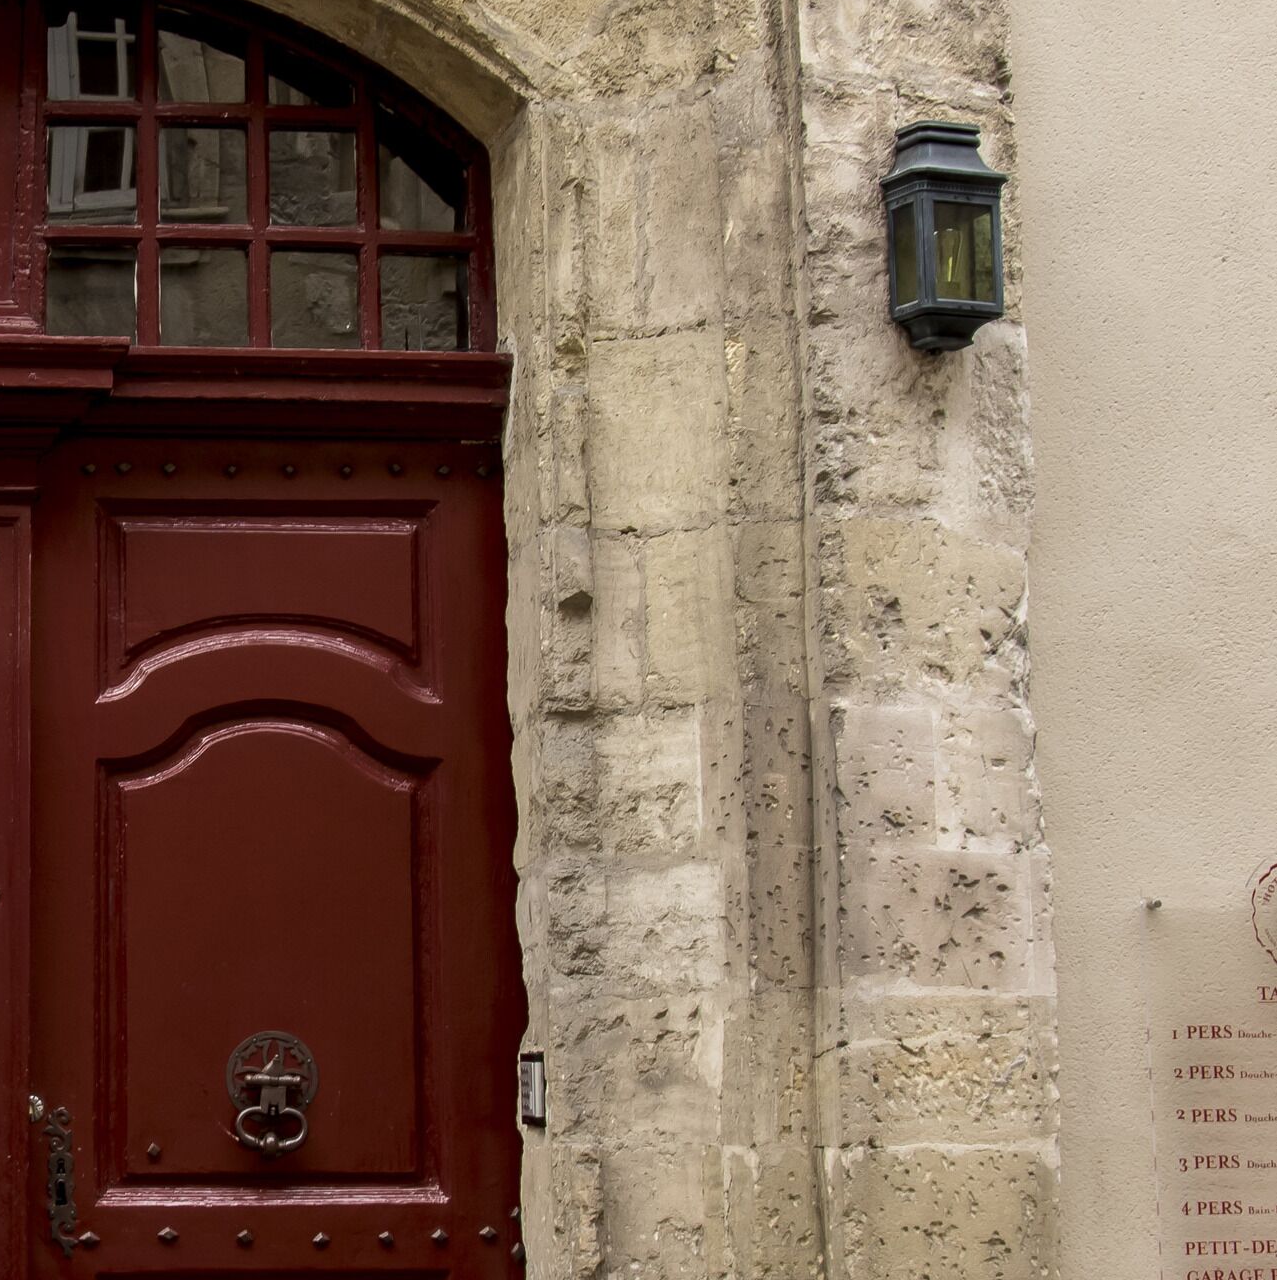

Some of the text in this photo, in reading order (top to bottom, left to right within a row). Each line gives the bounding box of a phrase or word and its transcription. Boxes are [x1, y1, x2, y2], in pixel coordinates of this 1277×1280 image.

[1187, 1025, 1233, 1039] PERS
[1174, 1068, 1183, 1079] 2
[1189, 1065, 1235, 1080] PERS
[1176, 1109, 1185, 1120] 2
[1192, 1108, 1238, 1123] PERS
[1179, 1158, 1188, 1173] 3
[1194, 1154, 1240, 1169] PERS
[1181, 1200, 1277, 1216] 4 PERS Bain-
[1185, 1240, 1277, 1257] PETIT-DE
